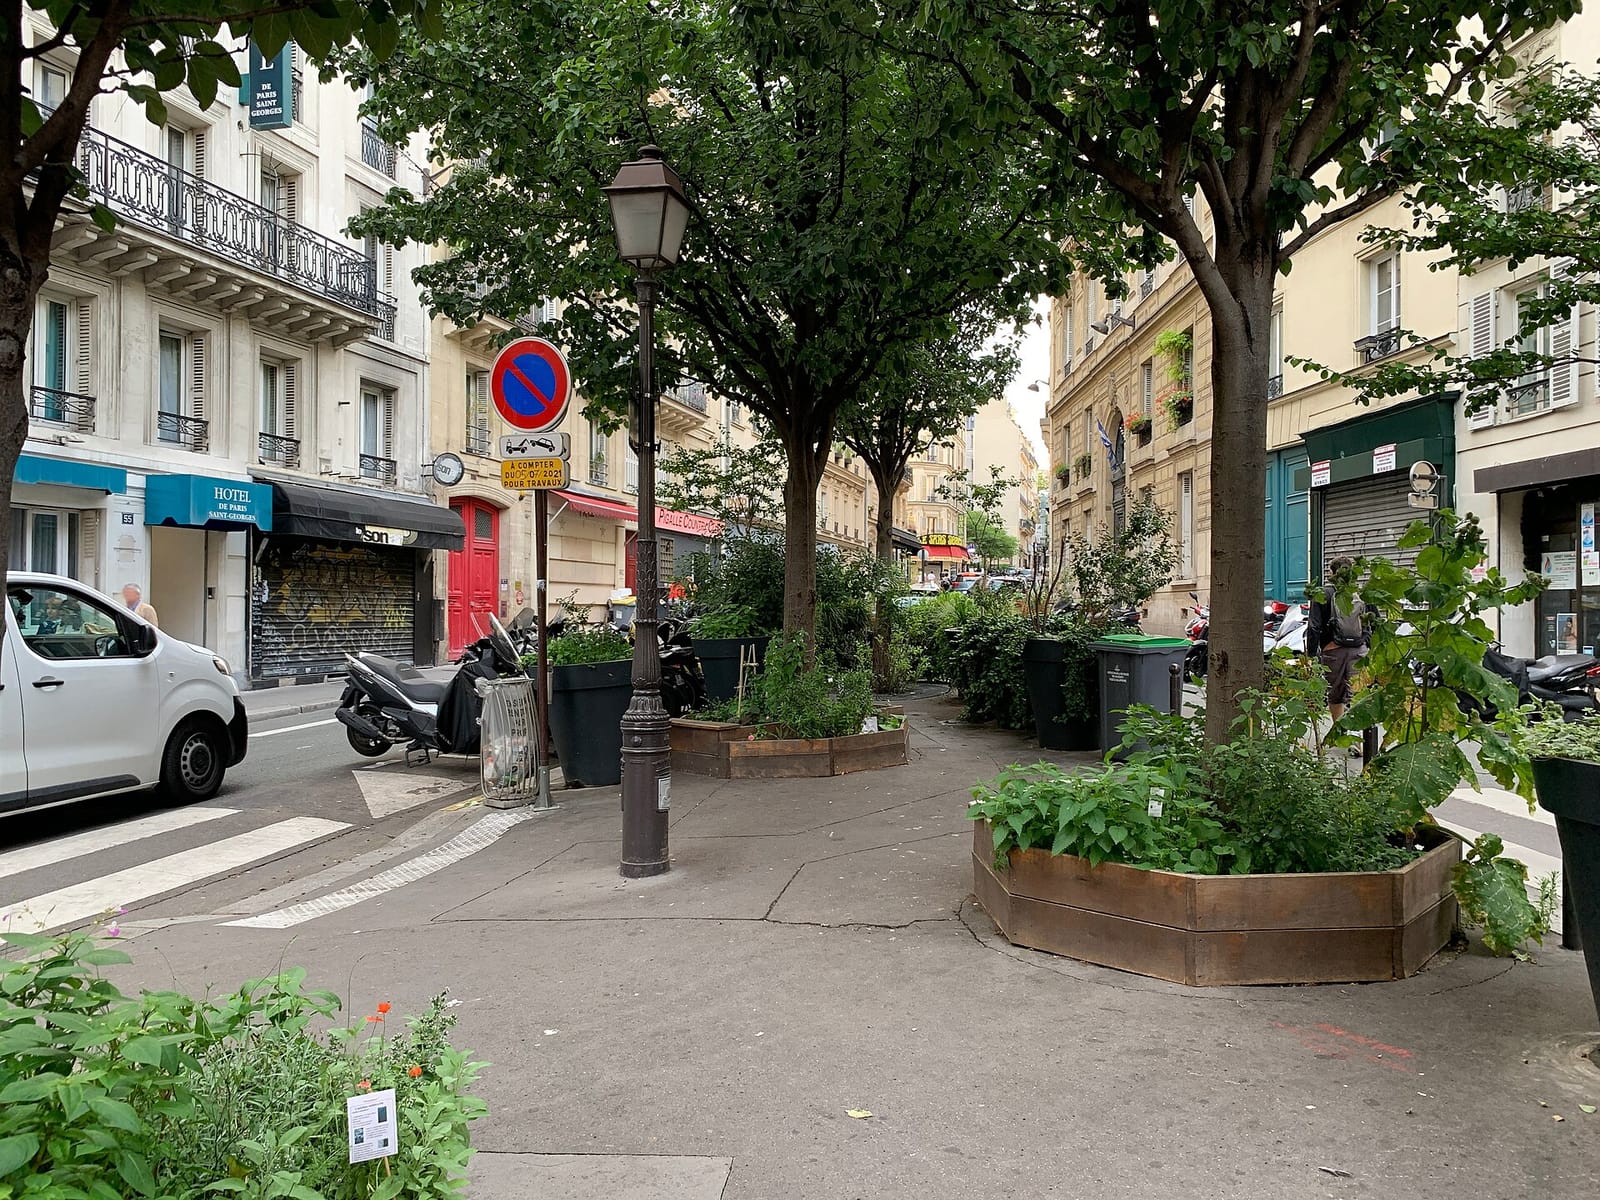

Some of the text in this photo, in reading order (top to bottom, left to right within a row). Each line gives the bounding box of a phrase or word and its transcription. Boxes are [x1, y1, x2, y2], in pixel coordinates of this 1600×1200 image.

[256, 91, 277, 99] PARIS
[256, 99, 277, 108] SAINT
[251, 107, 283, 117] GEORGES
[518, 461, 554, 469] COMPTER
[505, 471, 515, 479] DU
[504, 479, 562, 488] POUR TRAVAUX
[214, 486, 251, 503] HOTEL
[218, 503, 247, 512] DE PARIS
[123, 514, 133, 523] 55
[208, 510, 256, 521] SAINT-GEORGES
[363, 530, 389, 544] son
